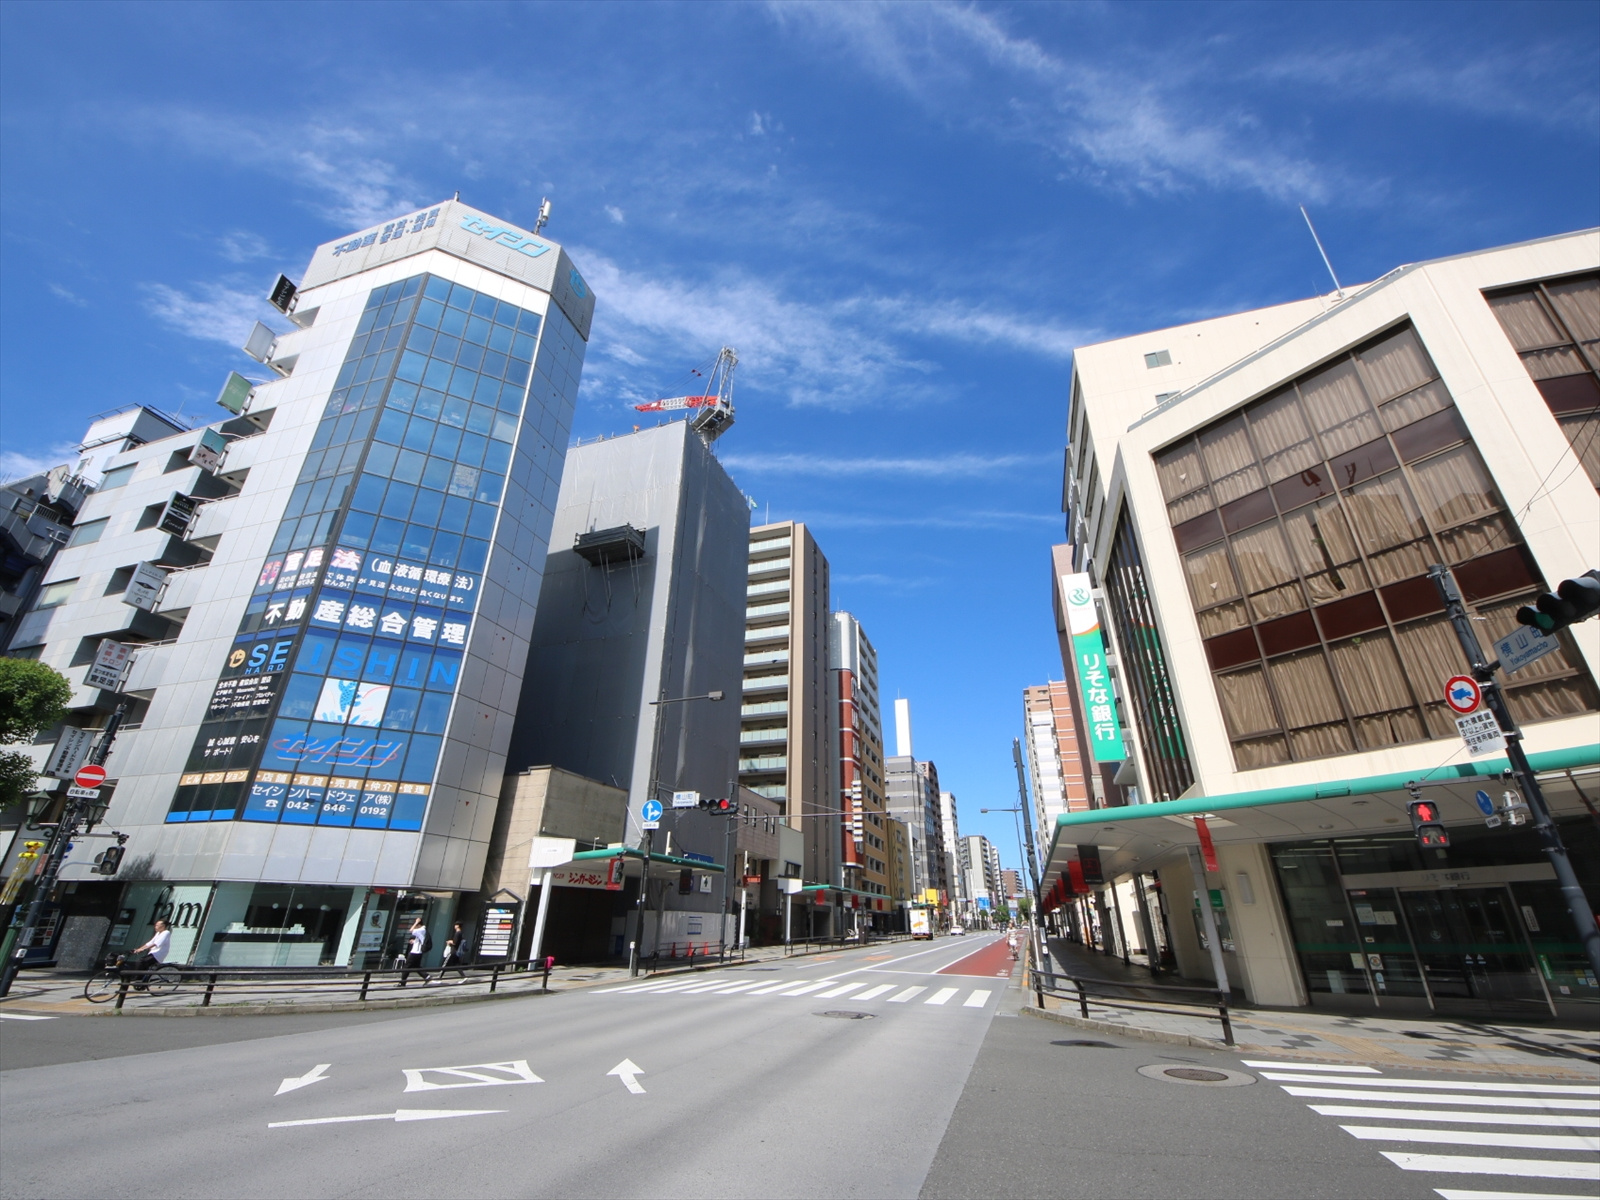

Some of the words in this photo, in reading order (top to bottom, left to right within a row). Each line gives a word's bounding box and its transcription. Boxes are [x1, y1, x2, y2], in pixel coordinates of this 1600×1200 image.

[459, 214, 550, 257] セイシン
[264, 598, 467, 645] 不動産総合管理
[1510, 641, 1548, 666] Yokoyamacho
[1083, 653, 1115, 741] りそな銀行
[568, 872, 603, 886] シンガーミシン
